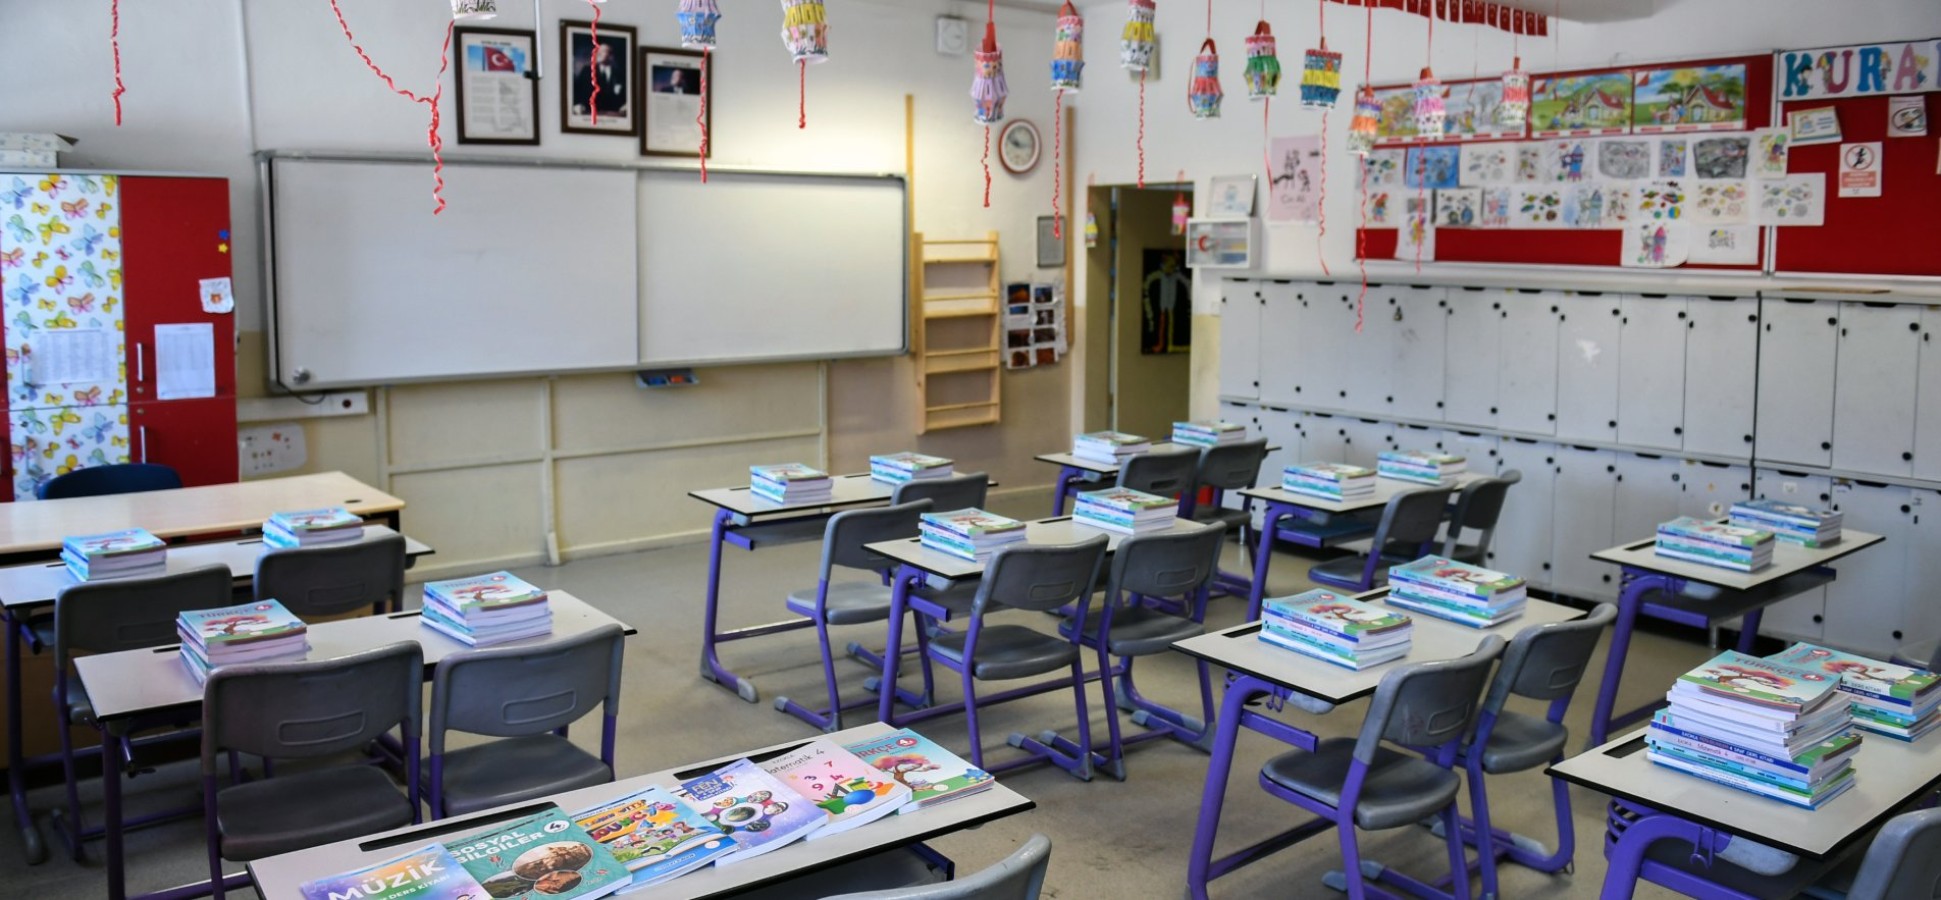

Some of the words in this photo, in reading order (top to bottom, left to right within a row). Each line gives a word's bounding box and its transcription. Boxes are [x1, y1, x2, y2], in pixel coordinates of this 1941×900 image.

[1783, 41, 1941, 97] KURA
[824, 760, 833, 768] 7
[549, 822, 561, 830] 4
[451, 831, 526, 857] SOSYAL
[328, 859, 446, 900] MÜZİK
[389, 887, 416, 900] DERS
